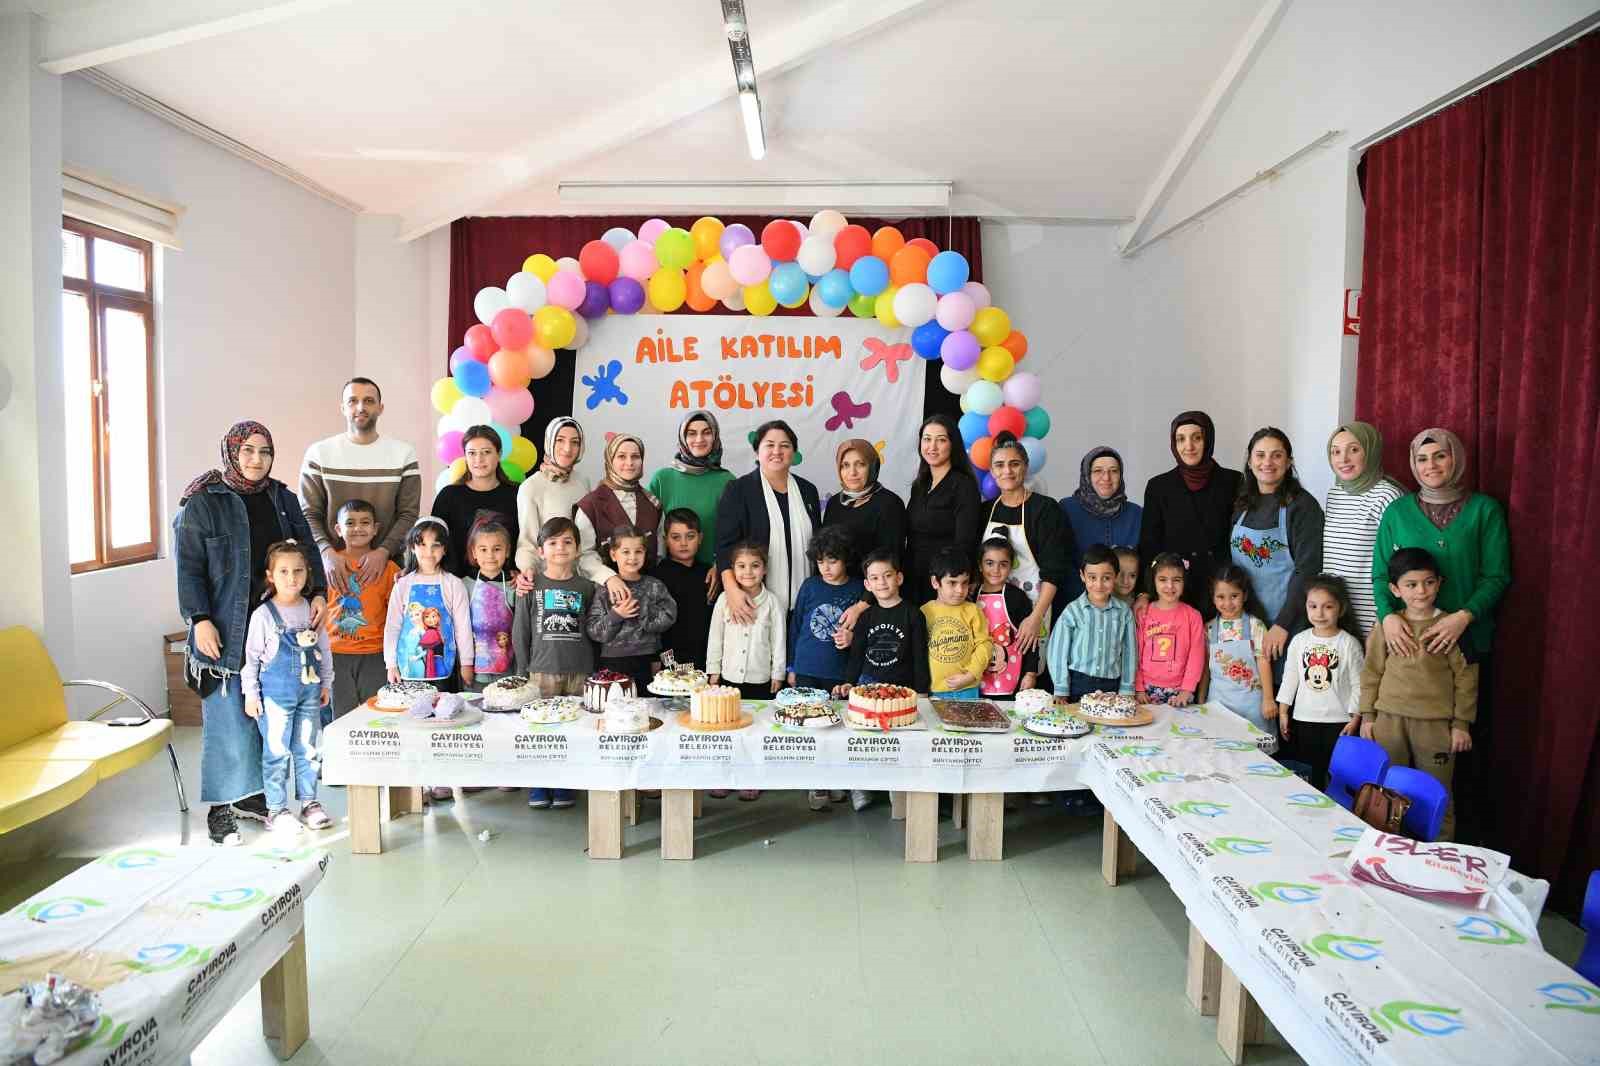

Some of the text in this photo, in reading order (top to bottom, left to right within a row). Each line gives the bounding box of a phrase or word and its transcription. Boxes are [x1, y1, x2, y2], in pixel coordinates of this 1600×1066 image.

[635, 328, 842, 364] AİLE KATILIM
[669, 374, 814, 410] ATÖLYESİ
[103, 1016, 158, 1066] AYIROVA
